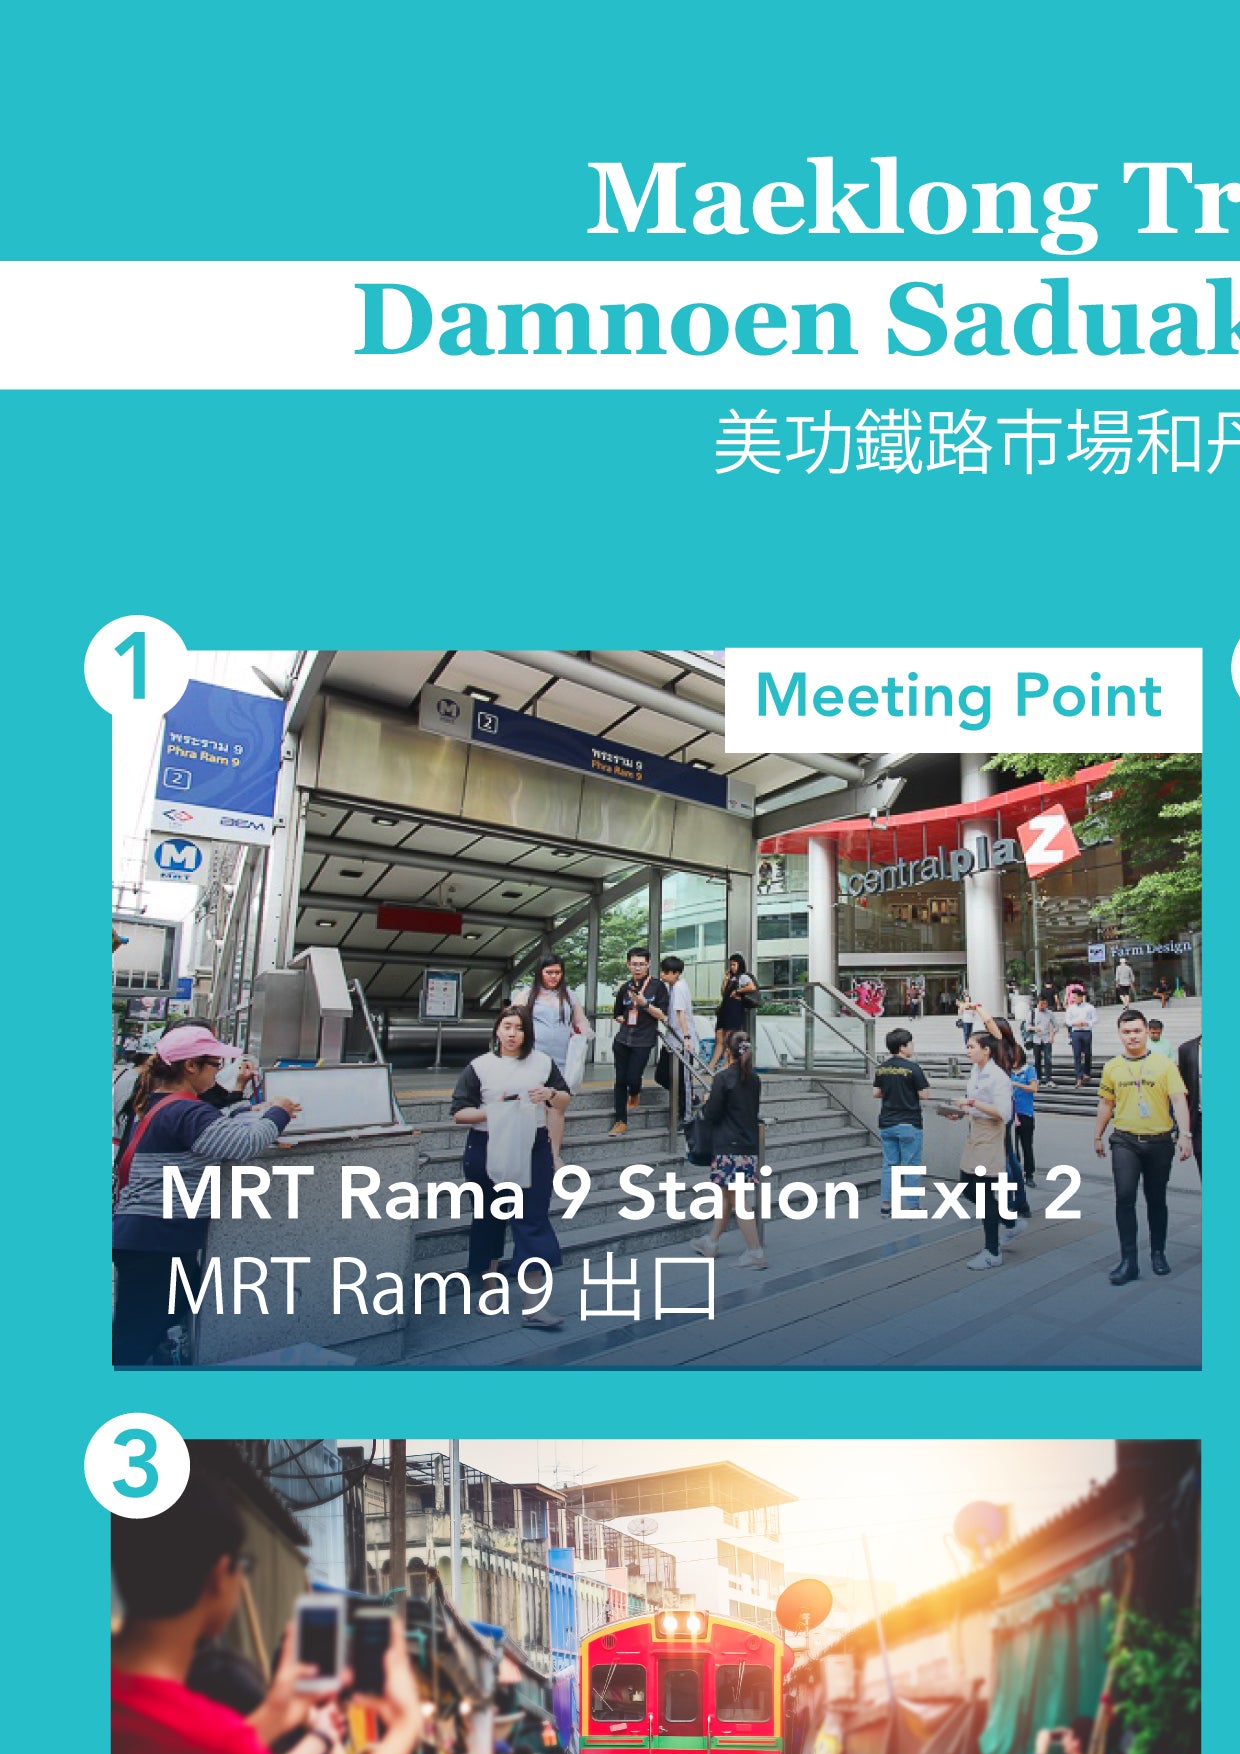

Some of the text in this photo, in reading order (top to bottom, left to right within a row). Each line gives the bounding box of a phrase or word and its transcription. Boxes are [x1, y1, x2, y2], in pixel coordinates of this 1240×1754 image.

[483, 713, 492, 730] 2
[167, 744, 240, 768] Phra Ram 9
[172, 771, 183, 785] 2
